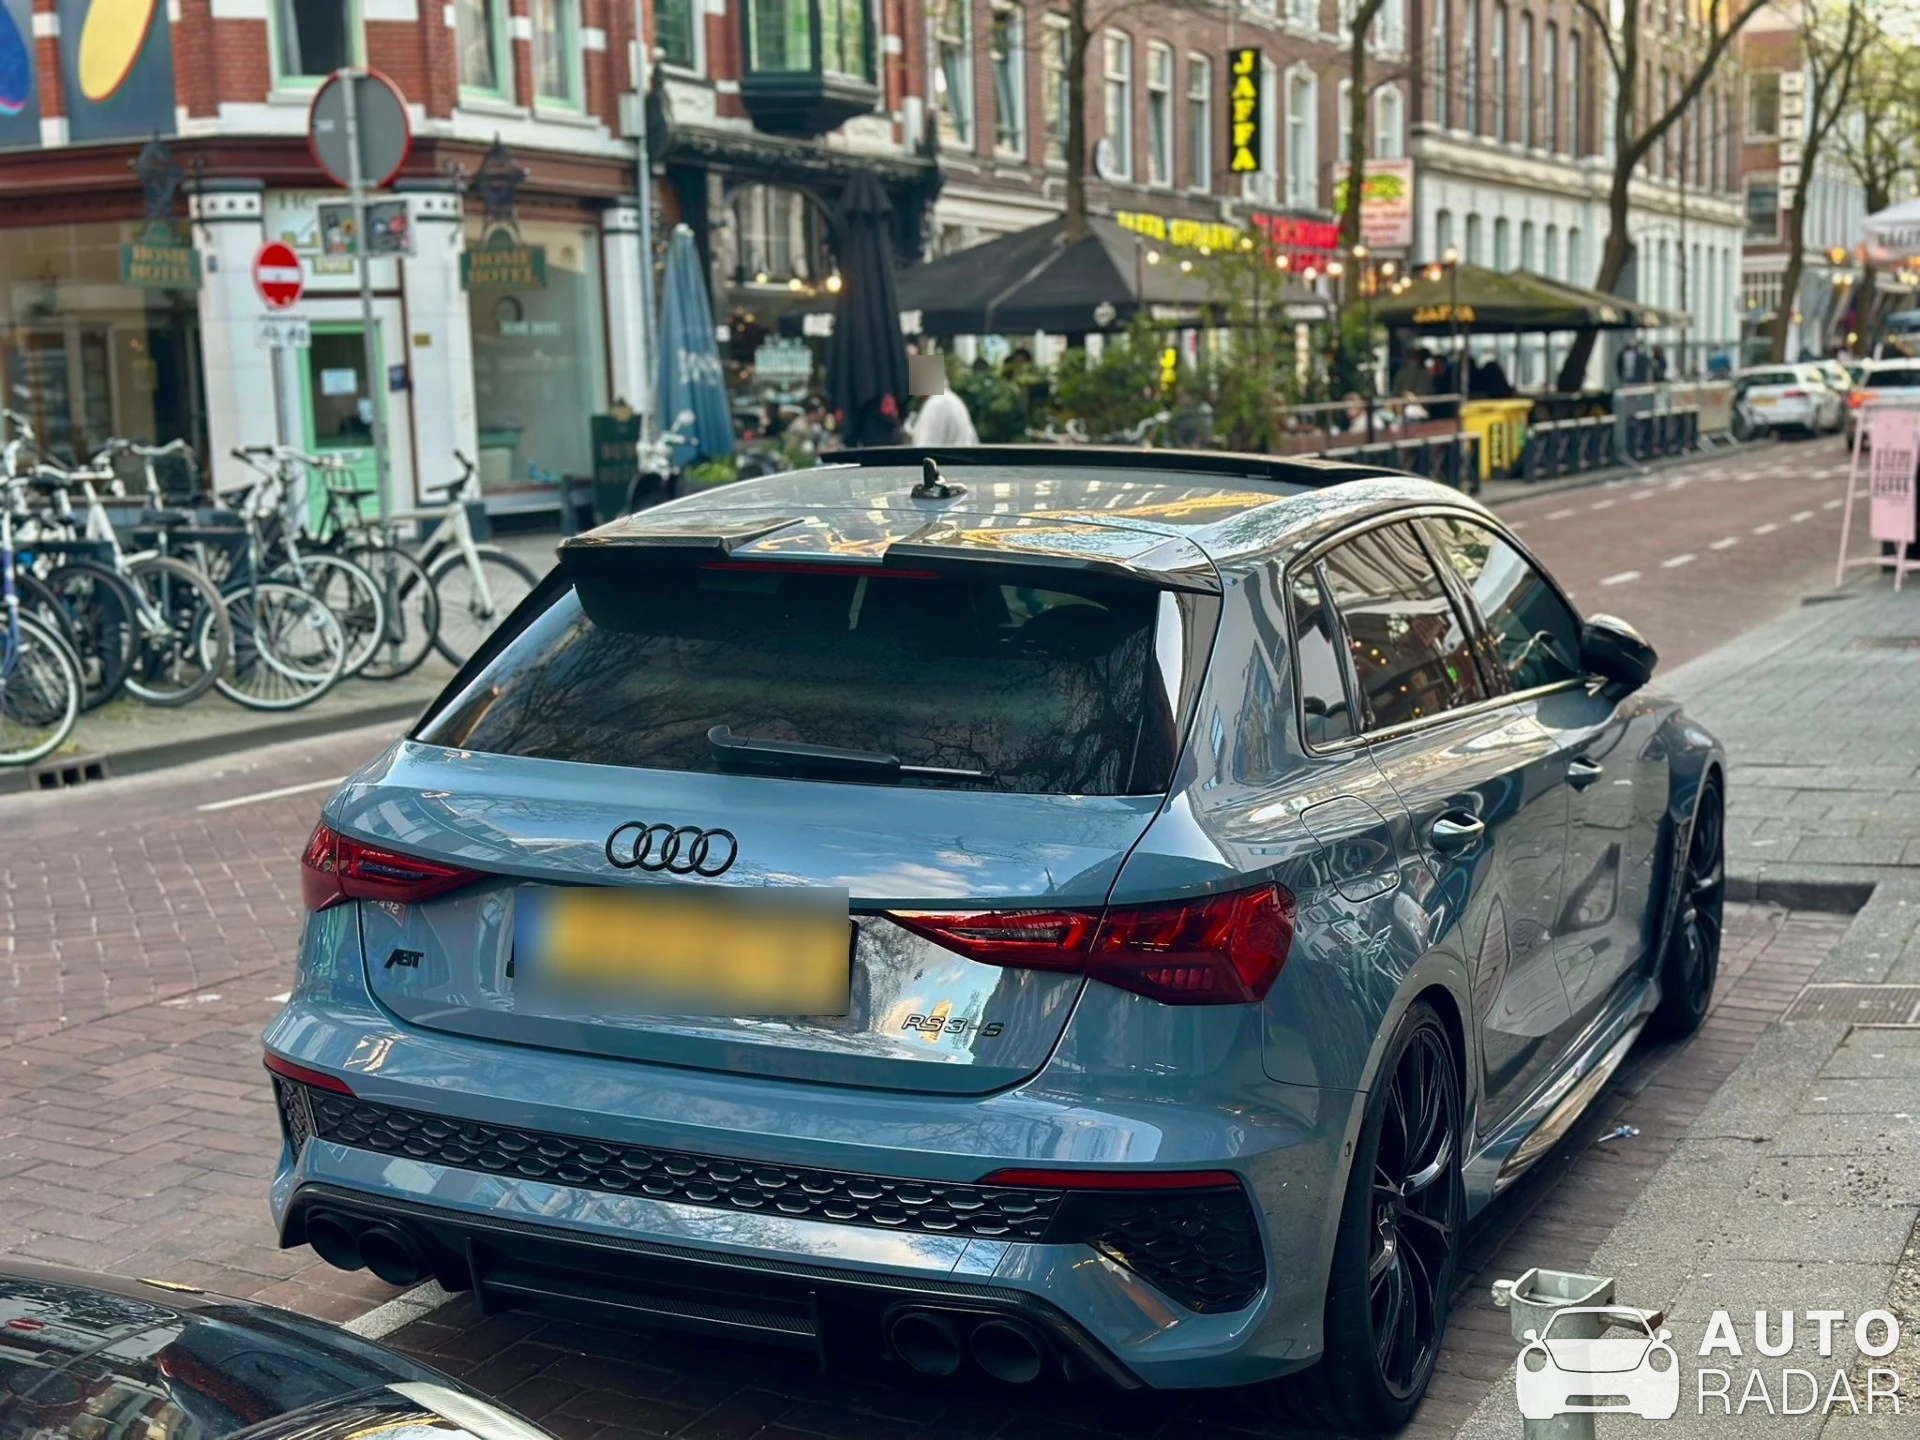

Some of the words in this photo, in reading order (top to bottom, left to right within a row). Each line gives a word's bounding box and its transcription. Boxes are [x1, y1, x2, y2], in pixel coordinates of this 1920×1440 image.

[1232, 51, 1256, 170] JAFFA
[131, 264, 191, 281] HOTEL
[384, 948, 424, 969] ABT
